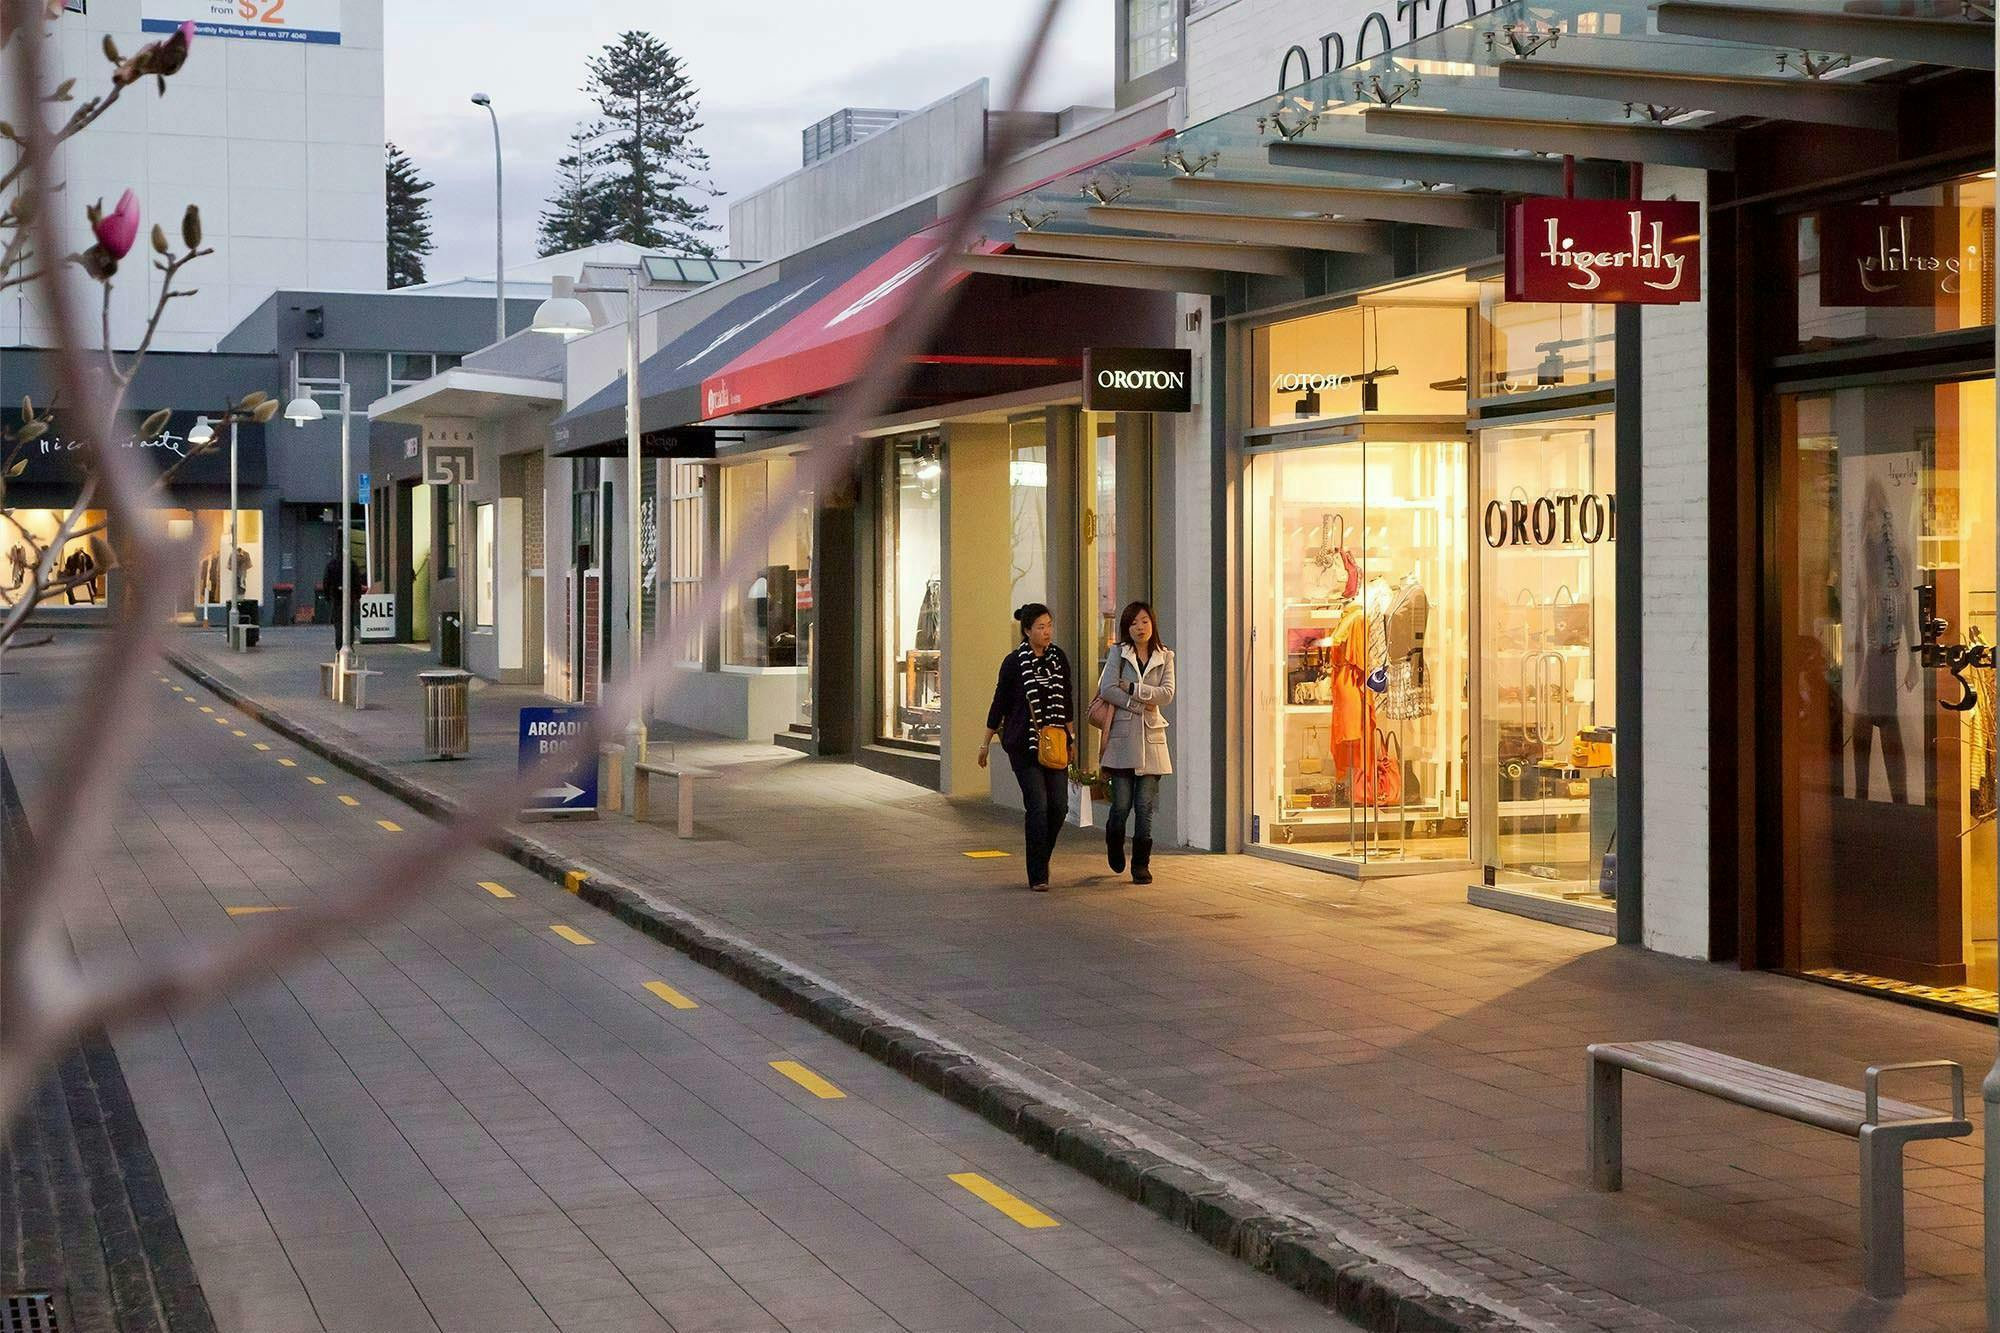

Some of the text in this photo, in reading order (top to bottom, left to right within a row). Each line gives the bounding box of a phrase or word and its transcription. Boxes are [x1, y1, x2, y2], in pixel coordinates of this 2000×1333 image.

[210, 0, 285, 24] from $2
[218, 27, 244, 37] Parking
[1541, 211, 1685, 290] tigerlily
[1098, 370, 1184, 389] OROTON
[428, 432, 474, 440] AREA
[433, 455, 468, 485] 51
[362, 602, 394, 618] SALE
